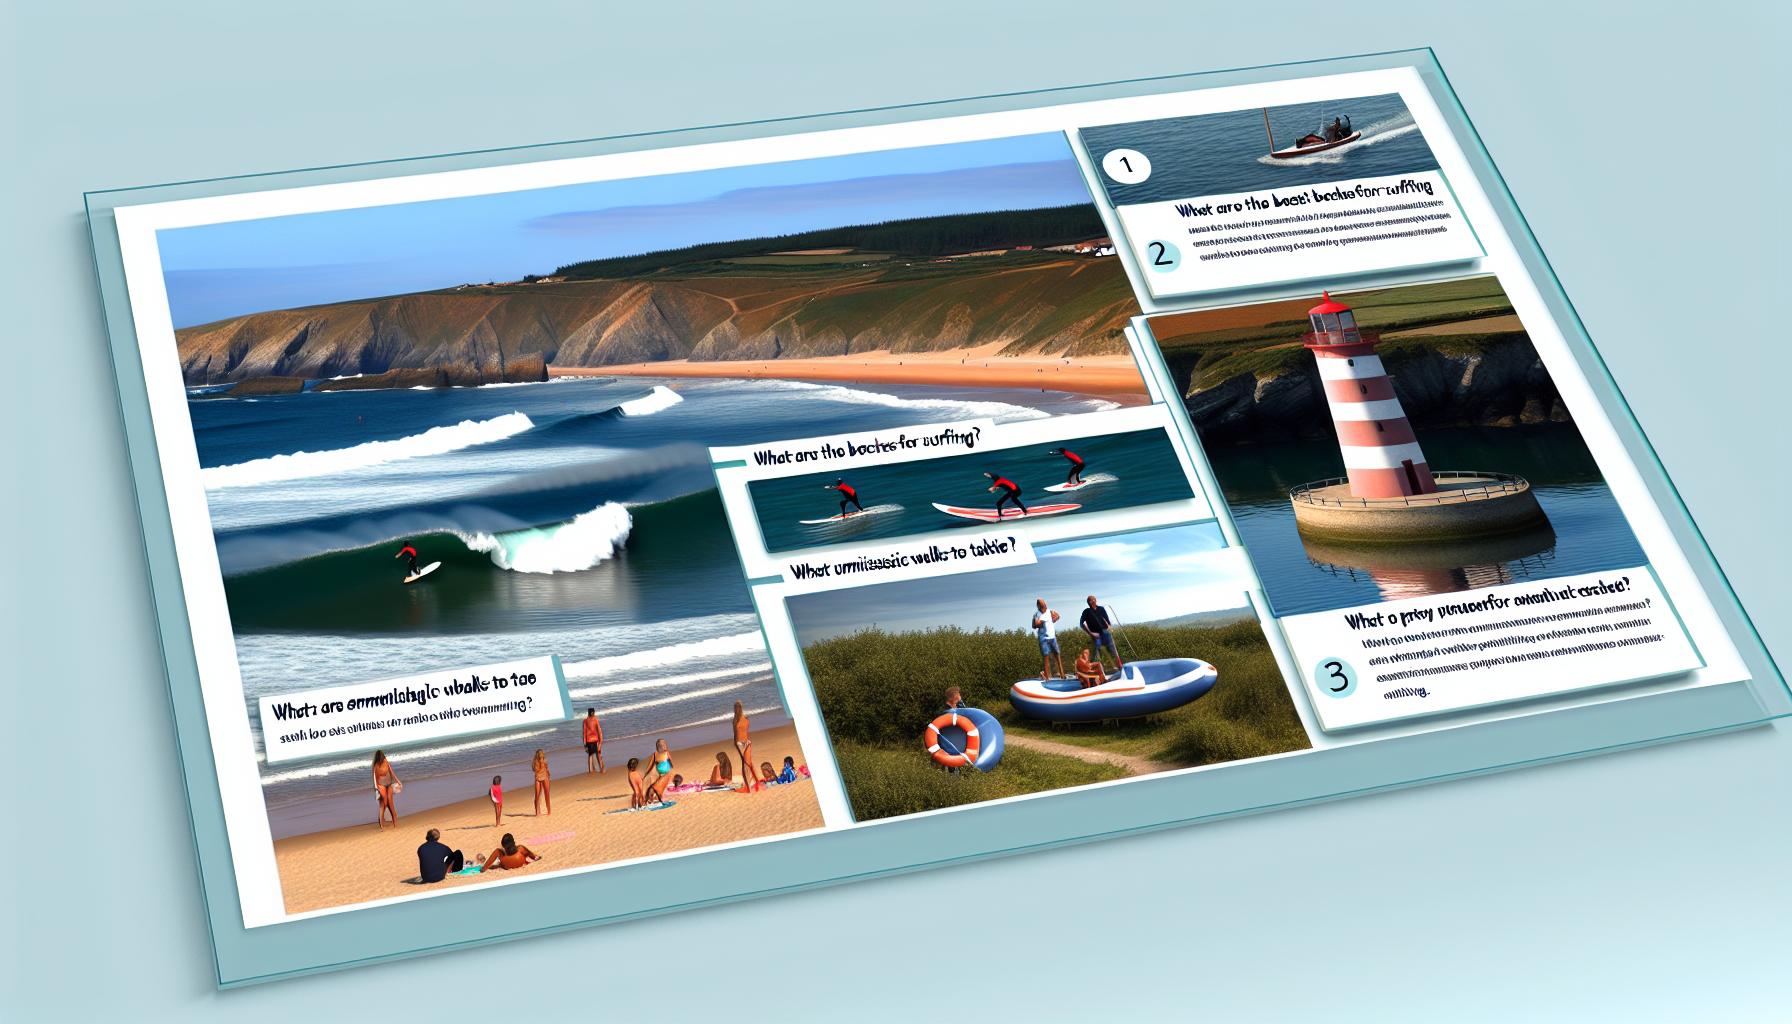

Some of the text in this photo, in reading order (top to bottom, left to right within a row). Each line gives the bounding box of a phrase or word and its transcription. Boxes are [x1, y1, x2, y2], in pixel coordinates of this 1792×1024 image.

[1119, 156, 1133, 173] 1
[1174, 202, 1214, 218] What
[1148, 241, 1174, 266] 2
[753, 449, 794, 466] What
[898, 434, 919, 449] for
[789, 562, 831, 580] What
[949, 546, 967, 560] to
[1344, 612, 1385, 631] What
[1324, 661, 1349, 692] 3
[320, 701, 344, 714] are
[491, 675, 509, 690] to
